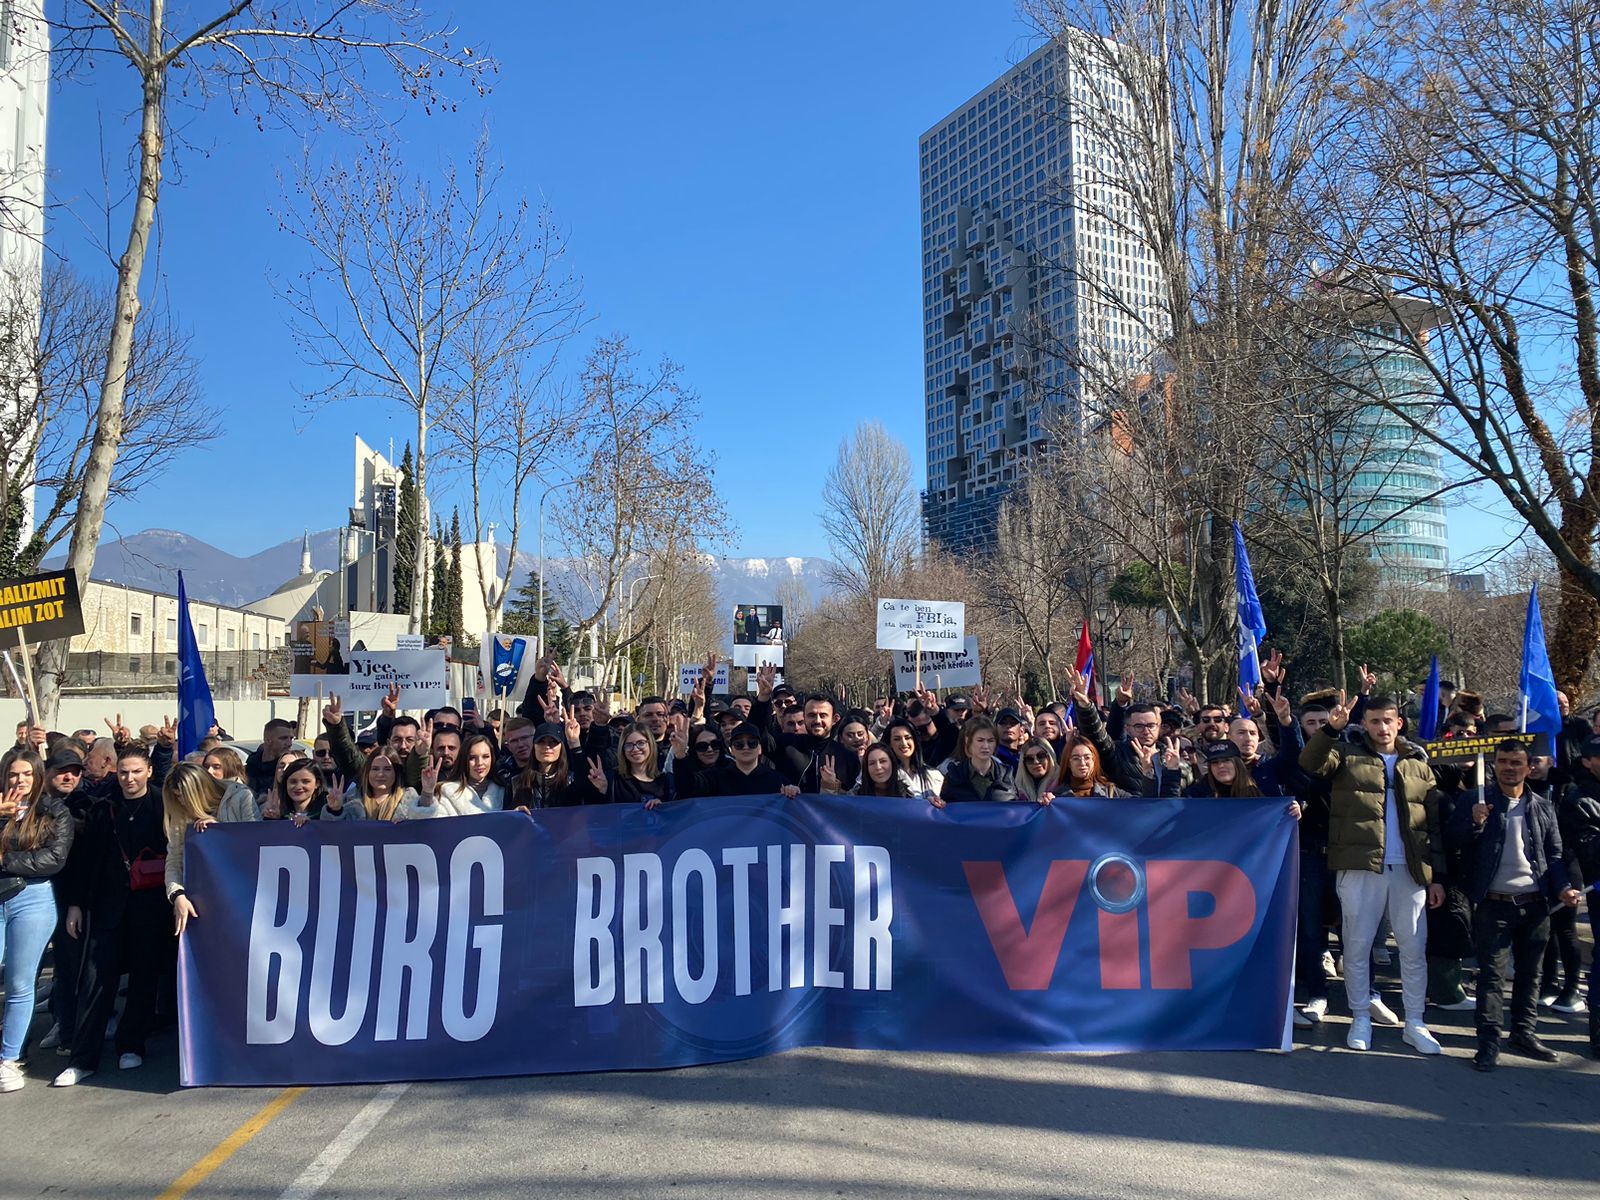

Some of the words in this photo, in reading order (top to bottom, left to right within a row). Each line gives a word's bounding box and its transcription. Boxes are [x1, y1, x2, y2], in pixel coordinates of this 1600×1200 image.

[34, 600, 64, 622] ZOT
[883, 602, 895, 611] Ca
[907, 629, 958, 639] perendia
[352, 659, 397, 677] Yjee,
[375, 672, 392, 680] gati
[413, 681, 441, 689] VIP?!
[1441, 745, 1495, 757] DALIM
[246, 835, 505, 1046] BURG
[574, 844, 893, 1008] BROTHER
